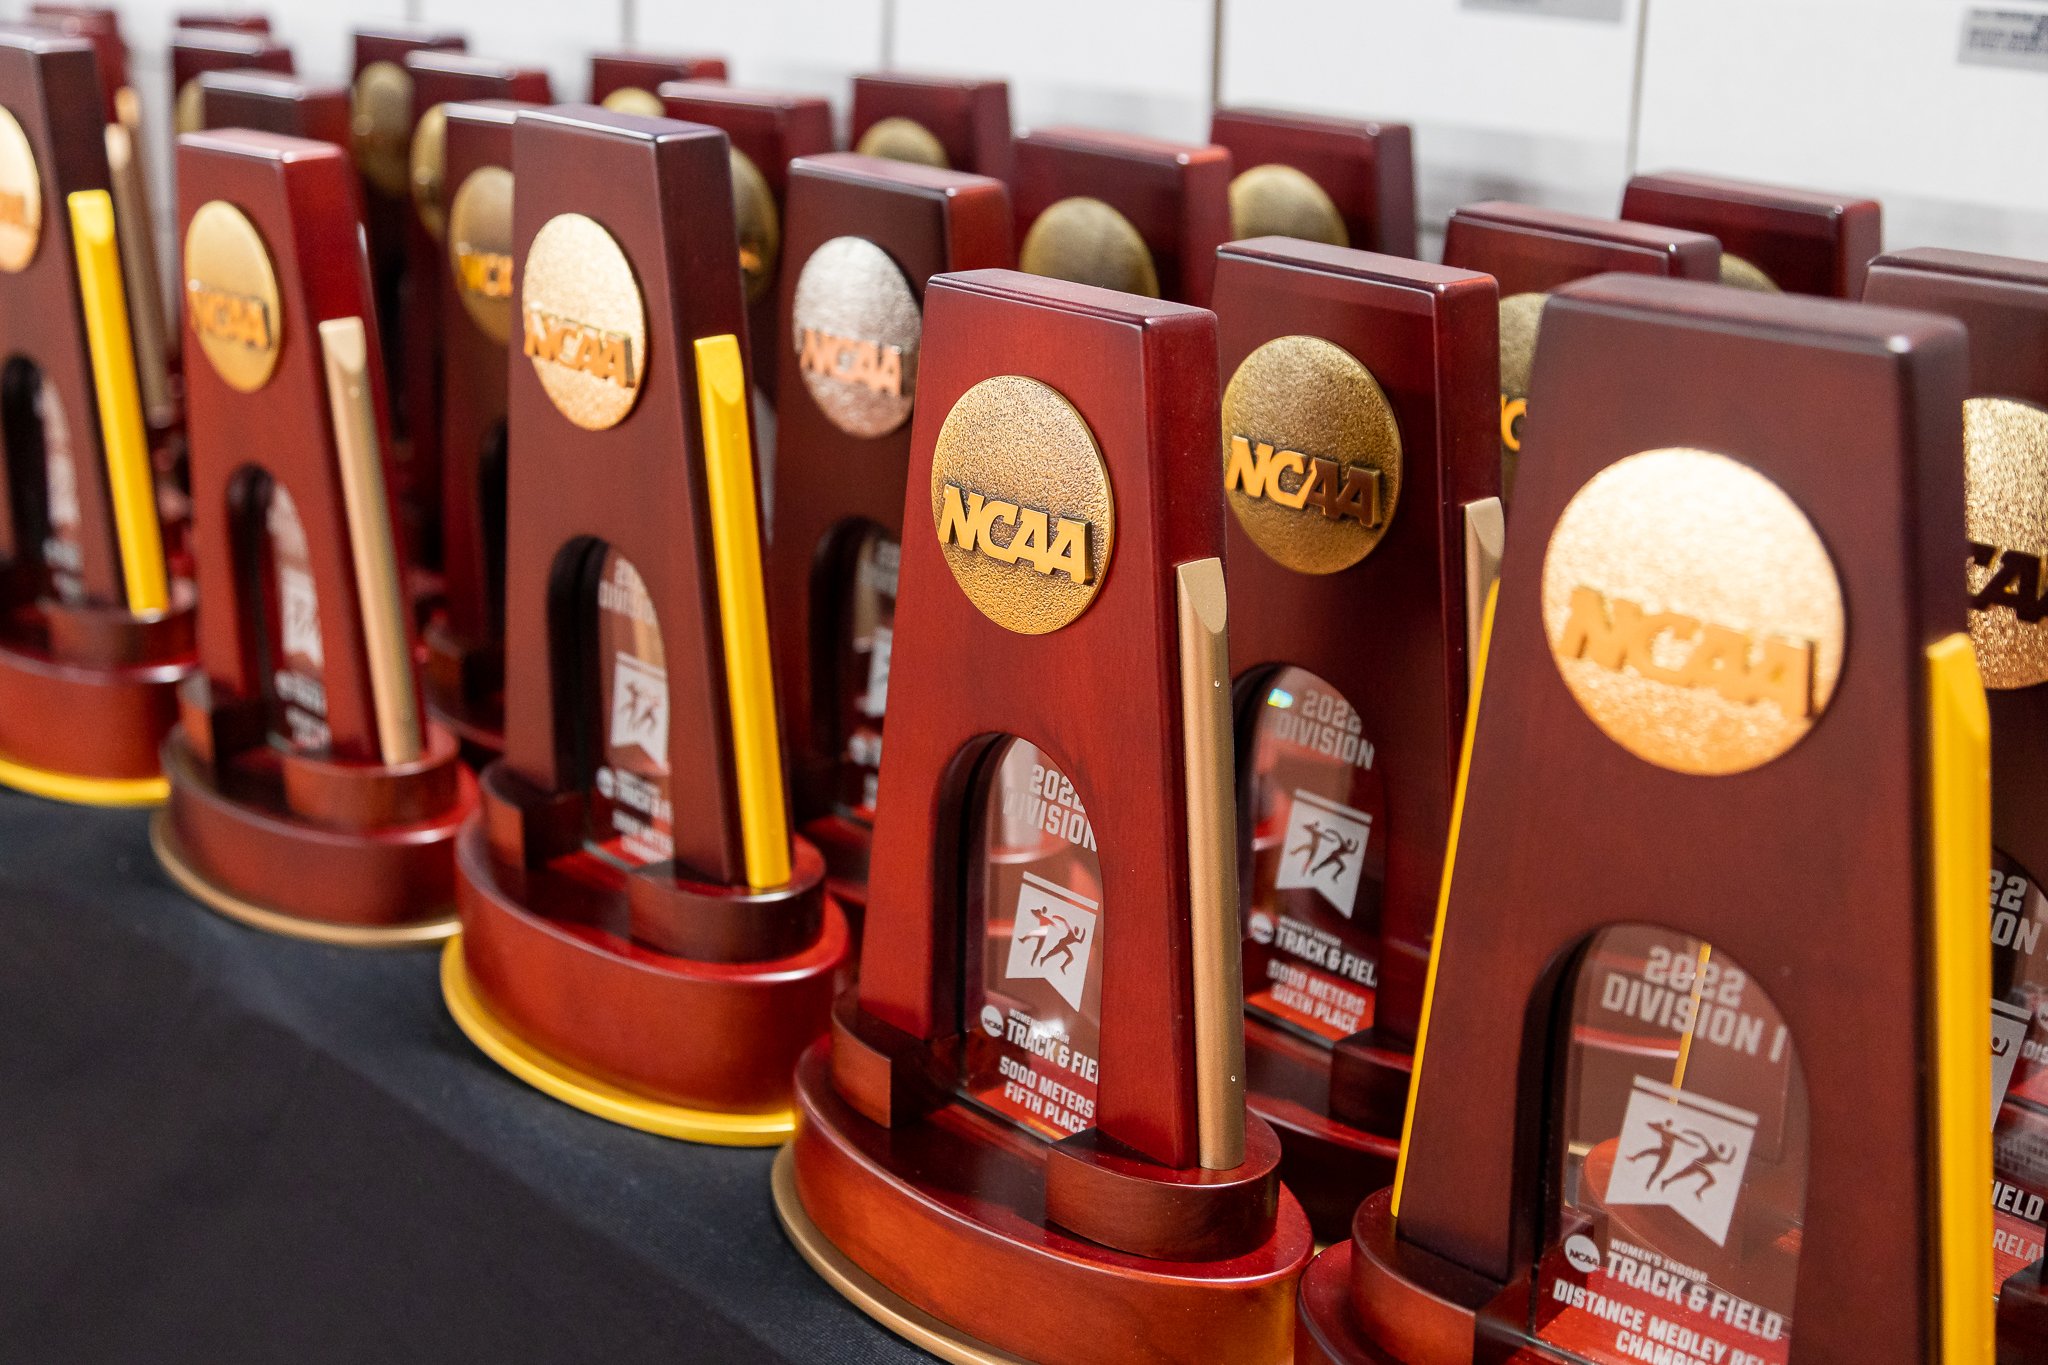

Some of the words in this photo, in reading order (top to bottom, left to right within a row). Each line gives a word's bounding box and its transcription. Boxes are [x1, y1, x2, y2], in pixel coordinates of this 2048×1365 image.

[523, 302, 635, 389] NCAA
[800, 327, 914, 398] NCAA
[1225, 434, 1384, 529] NCAA
[938, 482, 1093, 585] NCAA
[1554, 584, 1817, 722] NCAA
[1275, 711, 1375, 770] DIVISION
[1274, 924, 1328, 967] TRACK
[1326, 948, 1342, 971] &
[1340, 951, 1378, 988] FIEL
[1644, 944, 1747, 1009] 2022
[1007, 1018, 1057, 1063] TRACK
[1057, 1045, 1071, 1069] &
[1313, 1001, 1360, 1034] PLACE
[1601, 972, 1765, 1056] DIVISION
[1768, 1024, 1788, 1064] I
[998, 1055, 1038, 1090] 5000
[1038, 1075, 1095, 1120] METERS
[1003, 1080, 1043, 1115] FIFTH
[1043, 1099, 1089, 1133] PLACE
[1991, 1179, 2045, 1221] IELD
[1610, 1237, 1663, 1268] WOMEN'S
[1662, 1257, 1709, 1285] INDOOR
[1552, 1277, 1646, 1333] DISTANCE
[1646, 1314, 1728, 1364] MEDLEY
[1606, 1249, 1687, 1306] TRACK
[1687, 1283, 1709, 1314] &
[1709, 1292, 1784, 1342] FIELD
